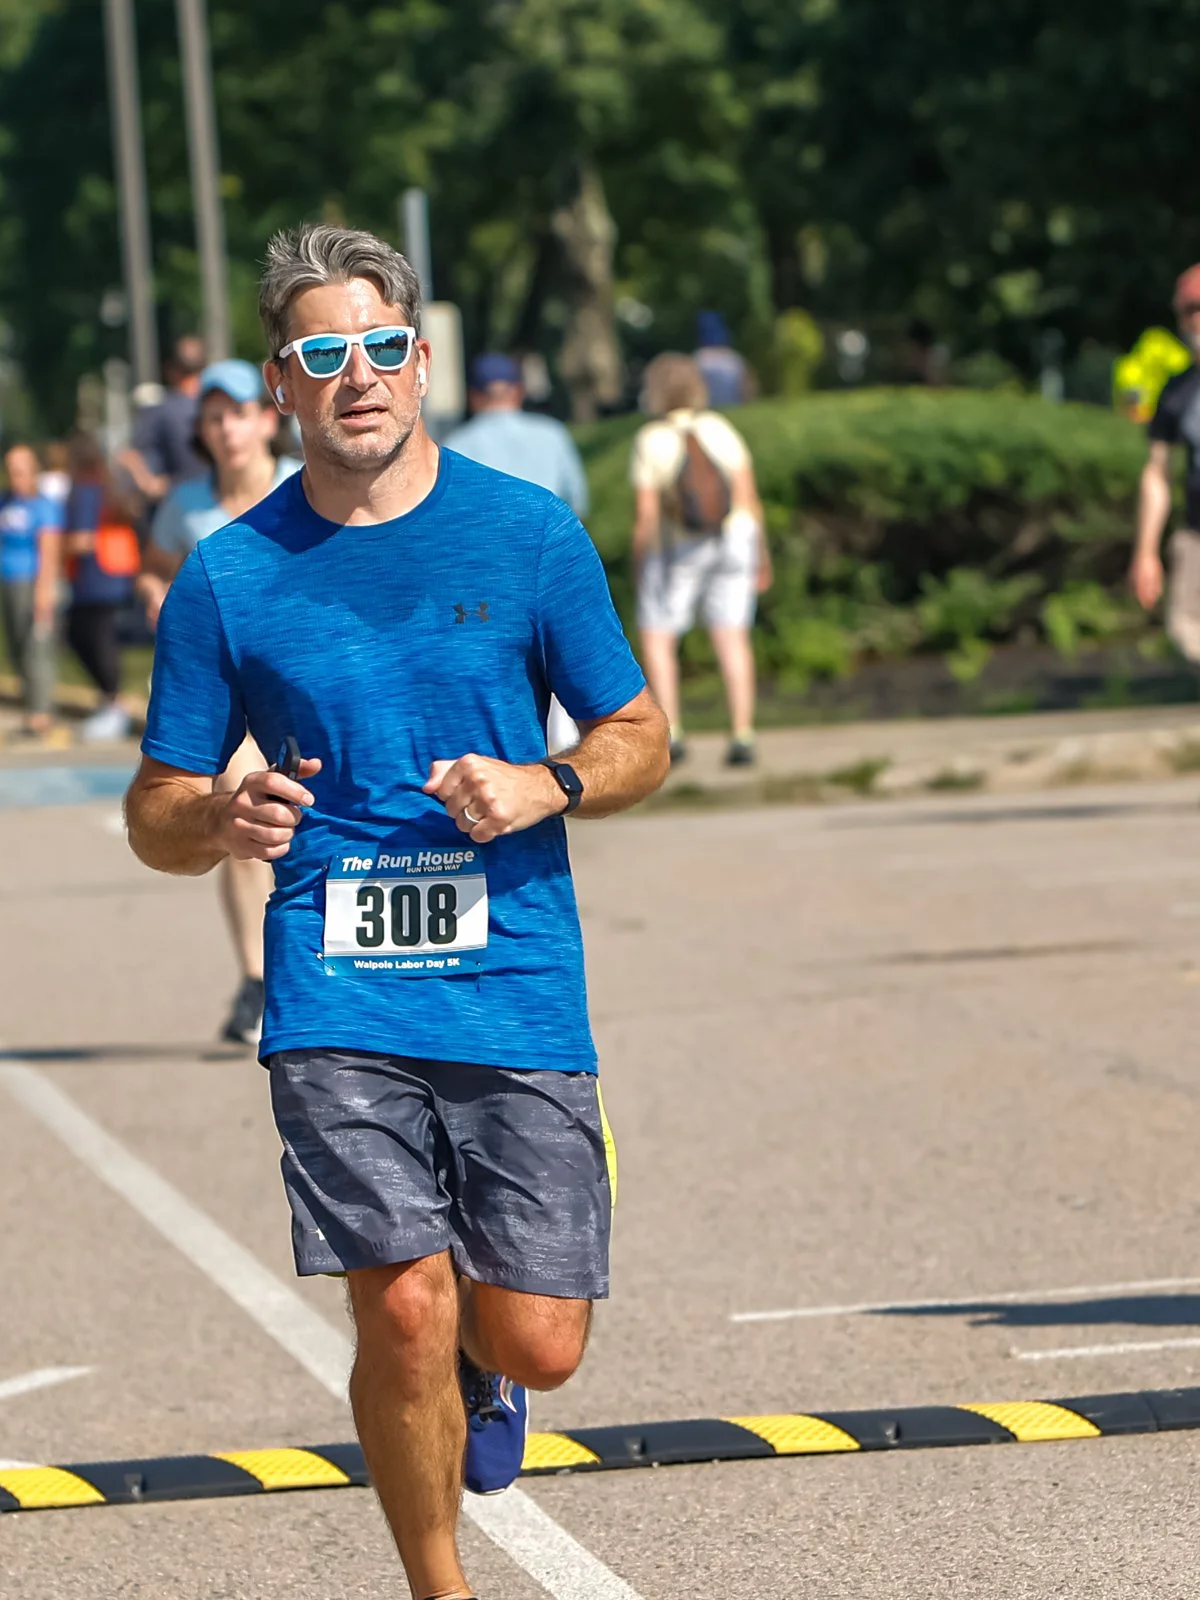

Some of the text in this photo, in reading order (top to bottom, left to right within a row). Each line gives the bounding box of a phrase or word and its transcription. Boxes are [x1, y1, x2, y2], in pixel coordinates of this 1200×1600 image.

[342, 850, 475, 872] The Run House
[423, 864, 443, 872] YOUR
[444, 863, 461, 871] WAY
[356, 883, 458, 948] 308
[354, 957, 460, 971] Walpole Labor Day 5K
